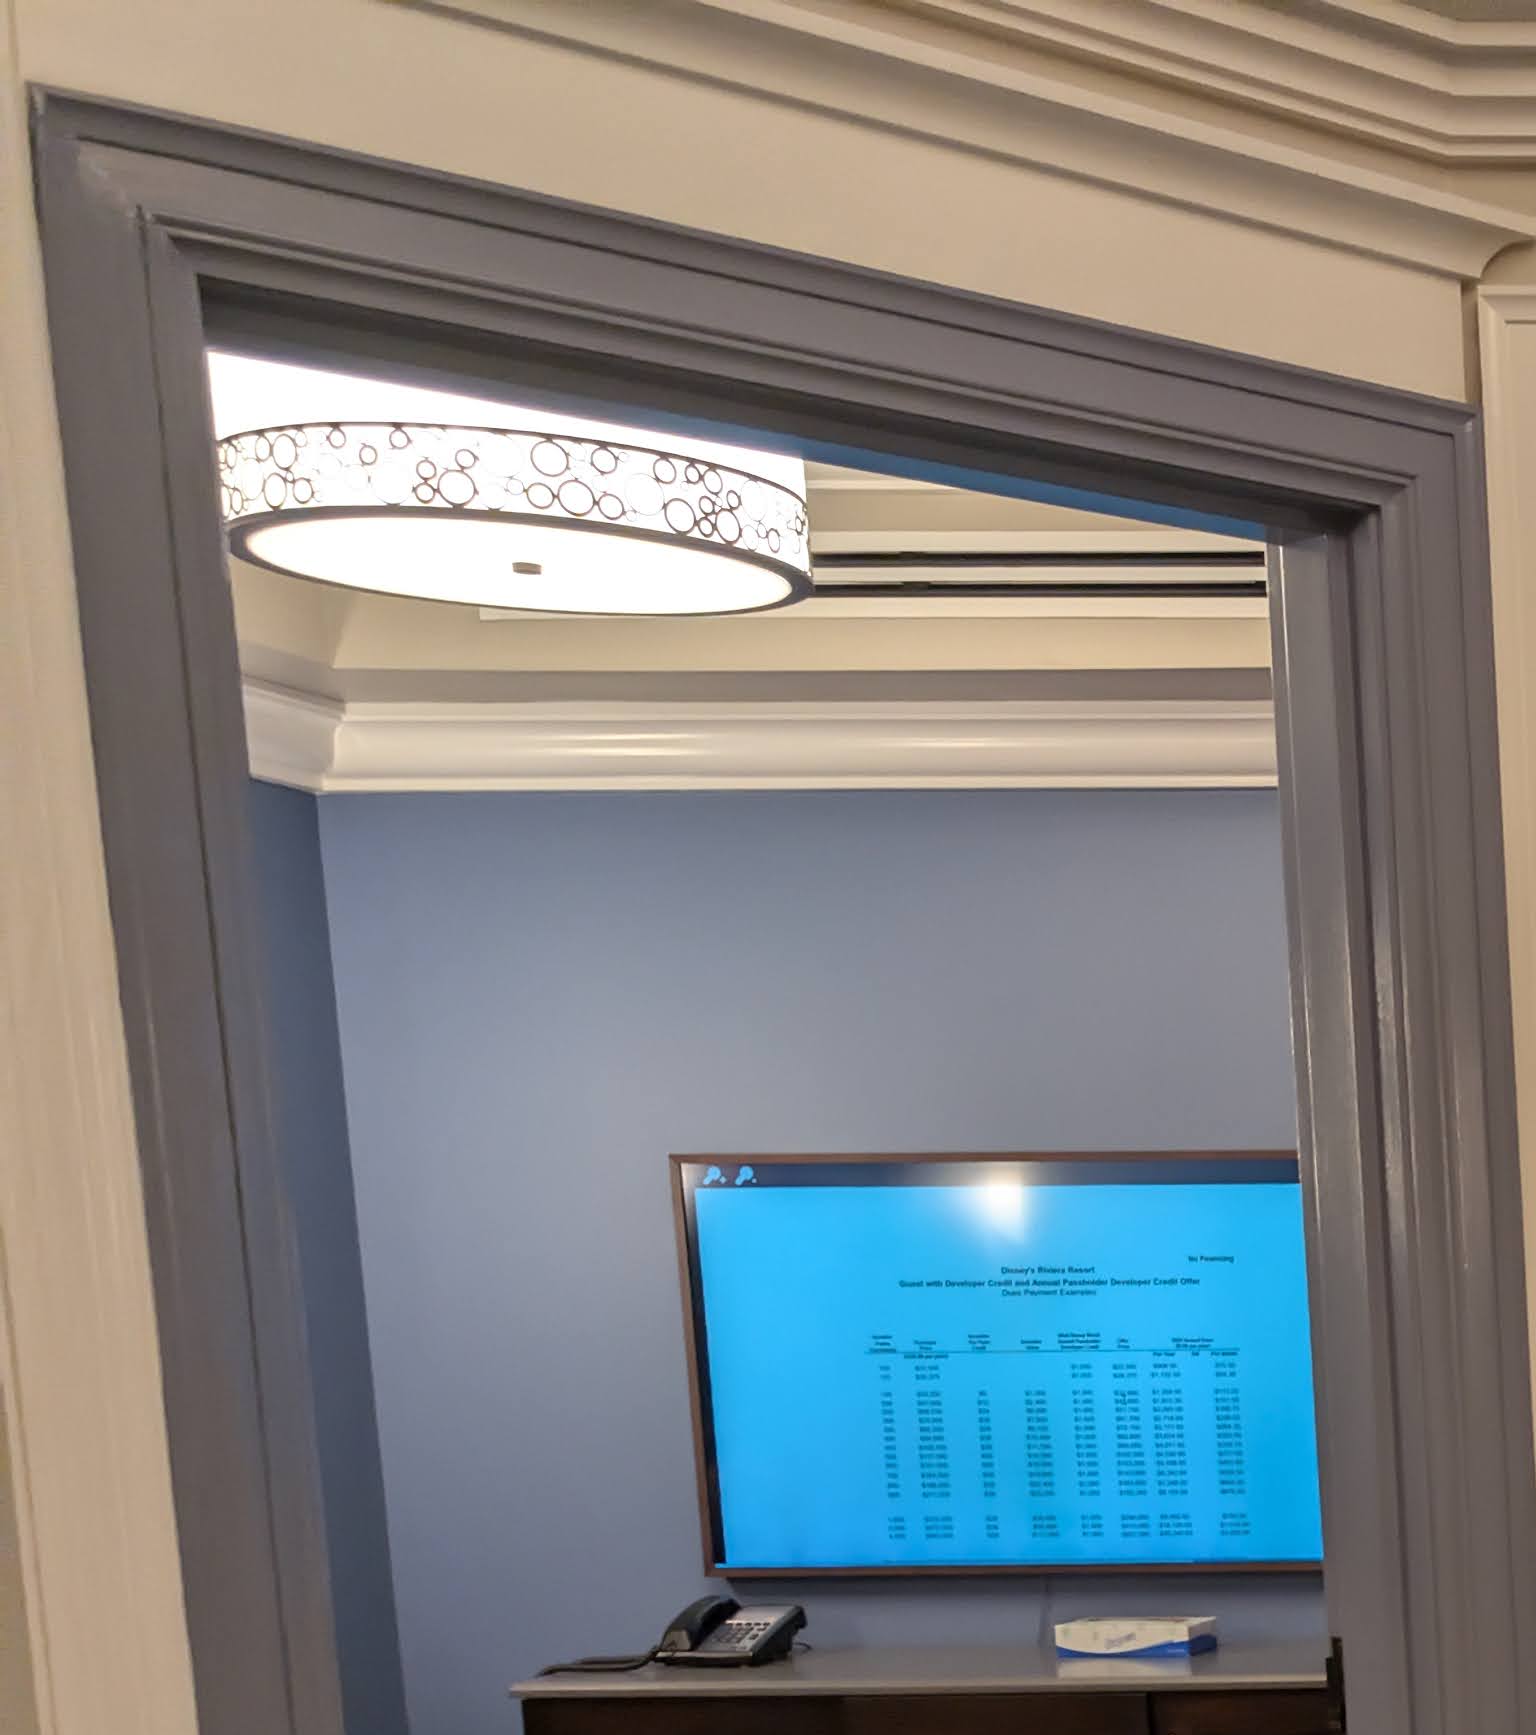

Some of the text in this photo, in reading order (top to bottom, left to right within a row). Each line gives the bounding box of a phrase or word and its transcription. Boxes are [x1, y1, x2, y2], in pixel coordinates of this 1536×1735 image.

[1001, 1266, 1035, 1275] Disney's
[945, 1280, 985, 1289] Developer
[988, 1279, 1012, 1287] Credit
[1015, 1279, 1029, 1287] and
[1032, 1279, 1060, 1287] Annual
[1110, 1278, 1151, 1287] Developer
[1153, 1278, 1178, 1286] Credit
[1180, 1278, 1200, 1286] Offer
